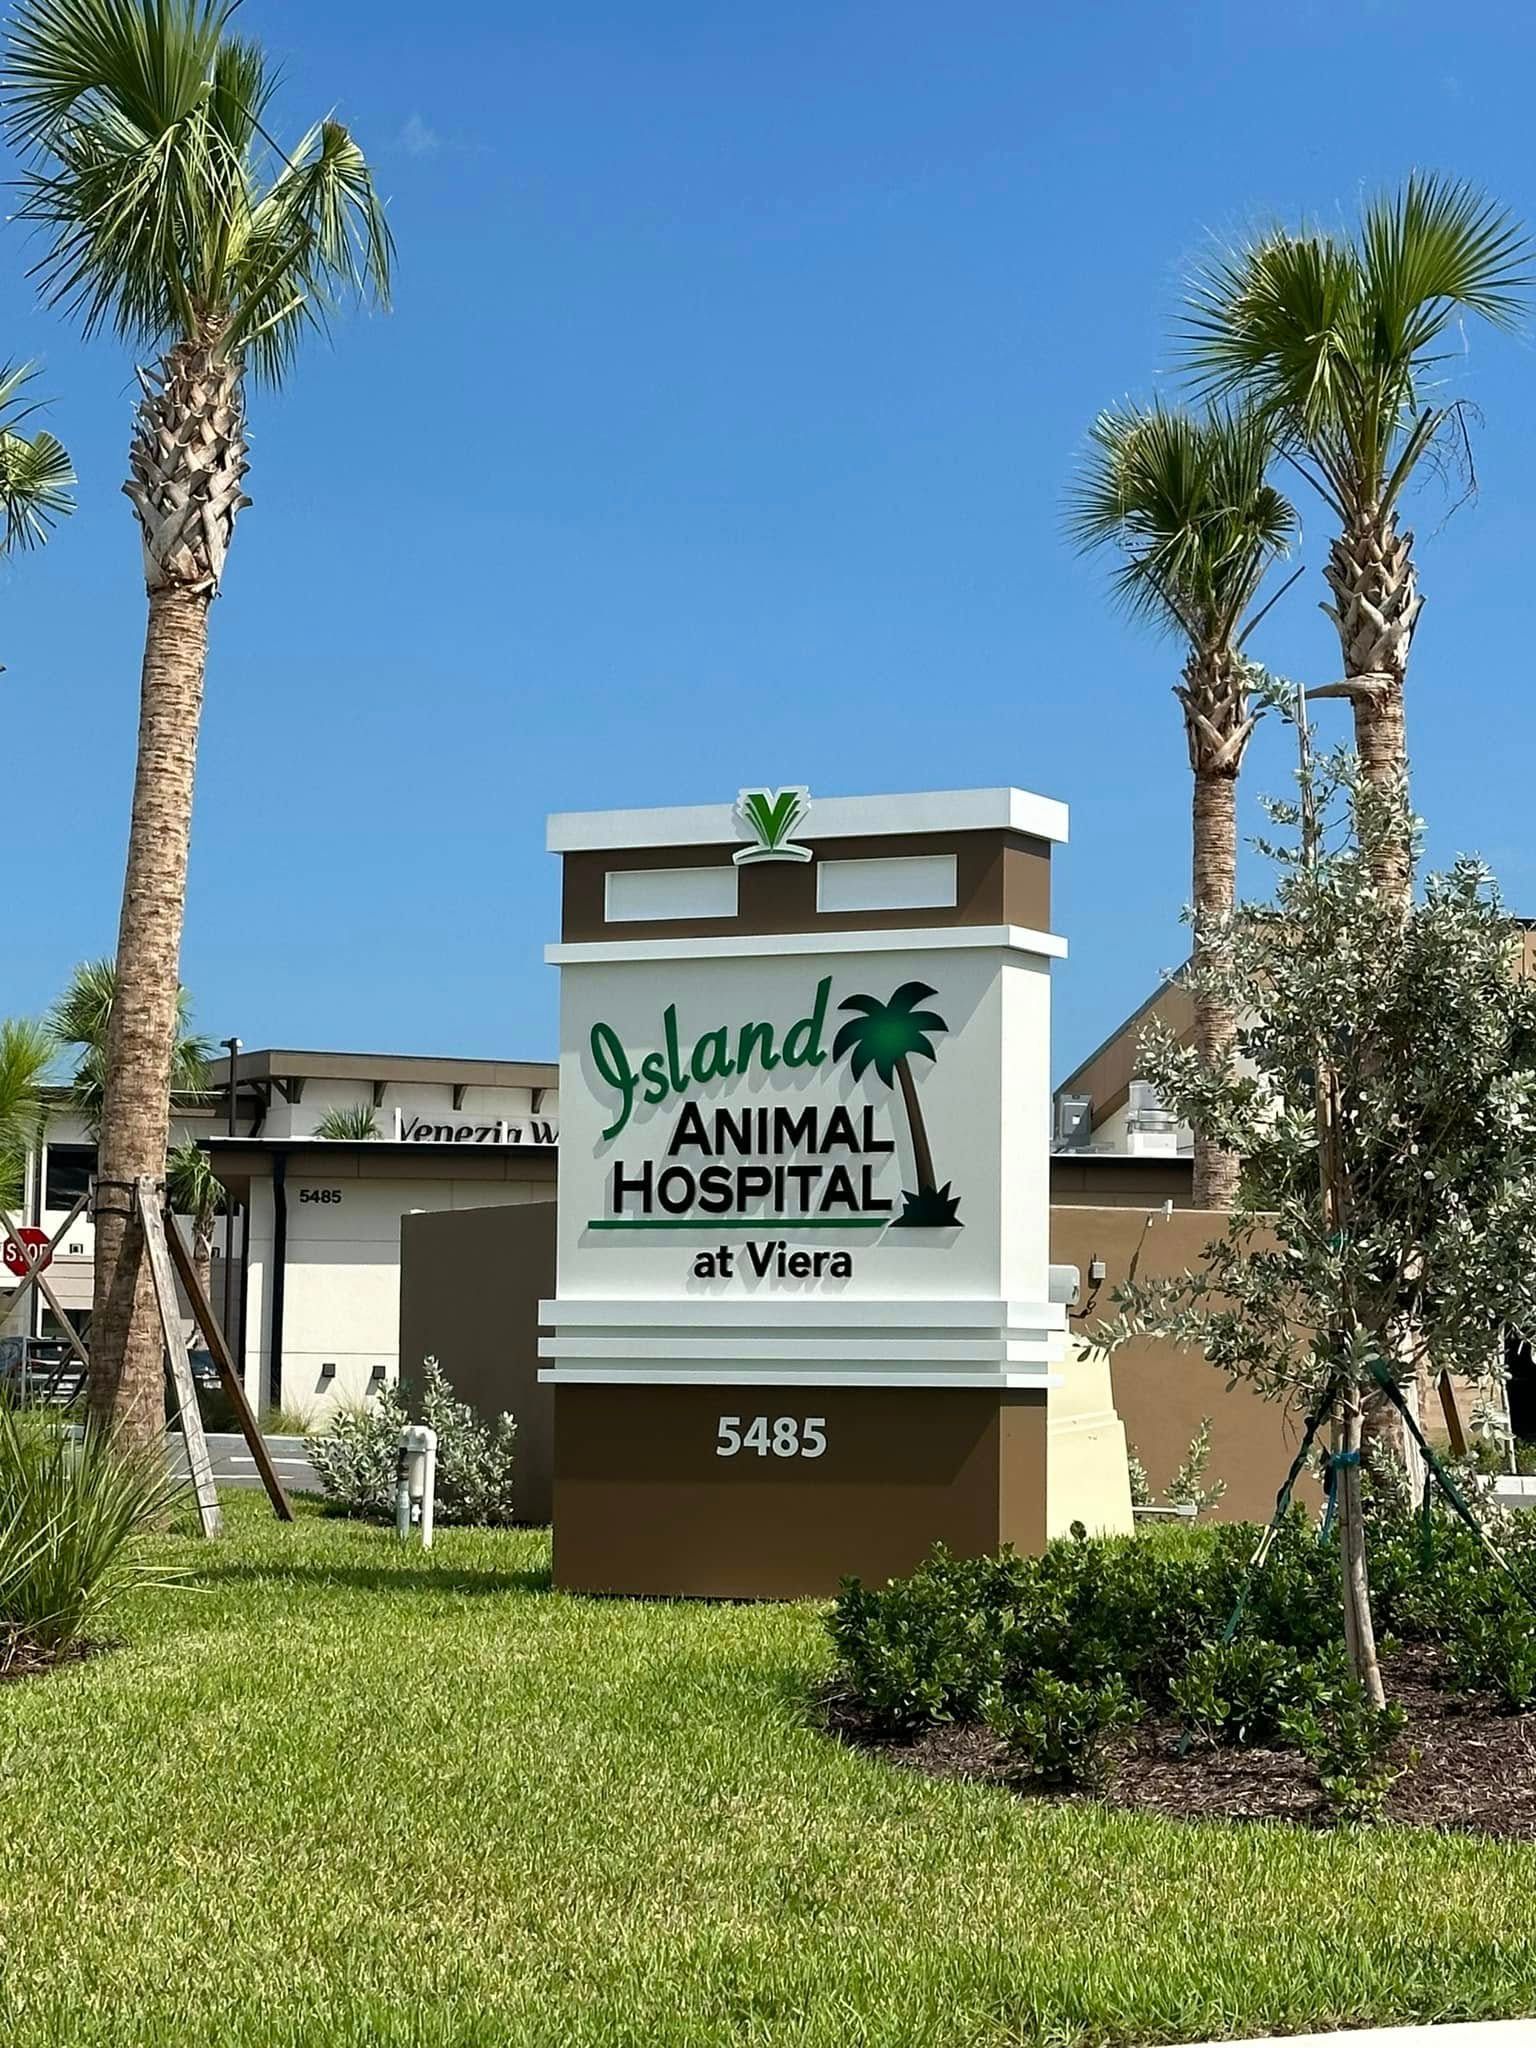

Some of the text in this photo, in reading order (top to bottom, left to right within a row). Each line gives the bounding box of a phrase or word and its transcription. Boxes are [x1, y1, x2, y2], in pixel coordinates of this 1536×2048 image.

[590, 975, 833, 1142] Island
[668, 1101, 894, 1156] ANIMAL
[300, 1189, 342, 1203] 5485
[613, 1160, 893, 1214] HOSPITAL
[6, 1243, 49, 1262] SO
[694, 1241, 852, 1278] at Viera
[716, 1416, 827, 1458] 5485
